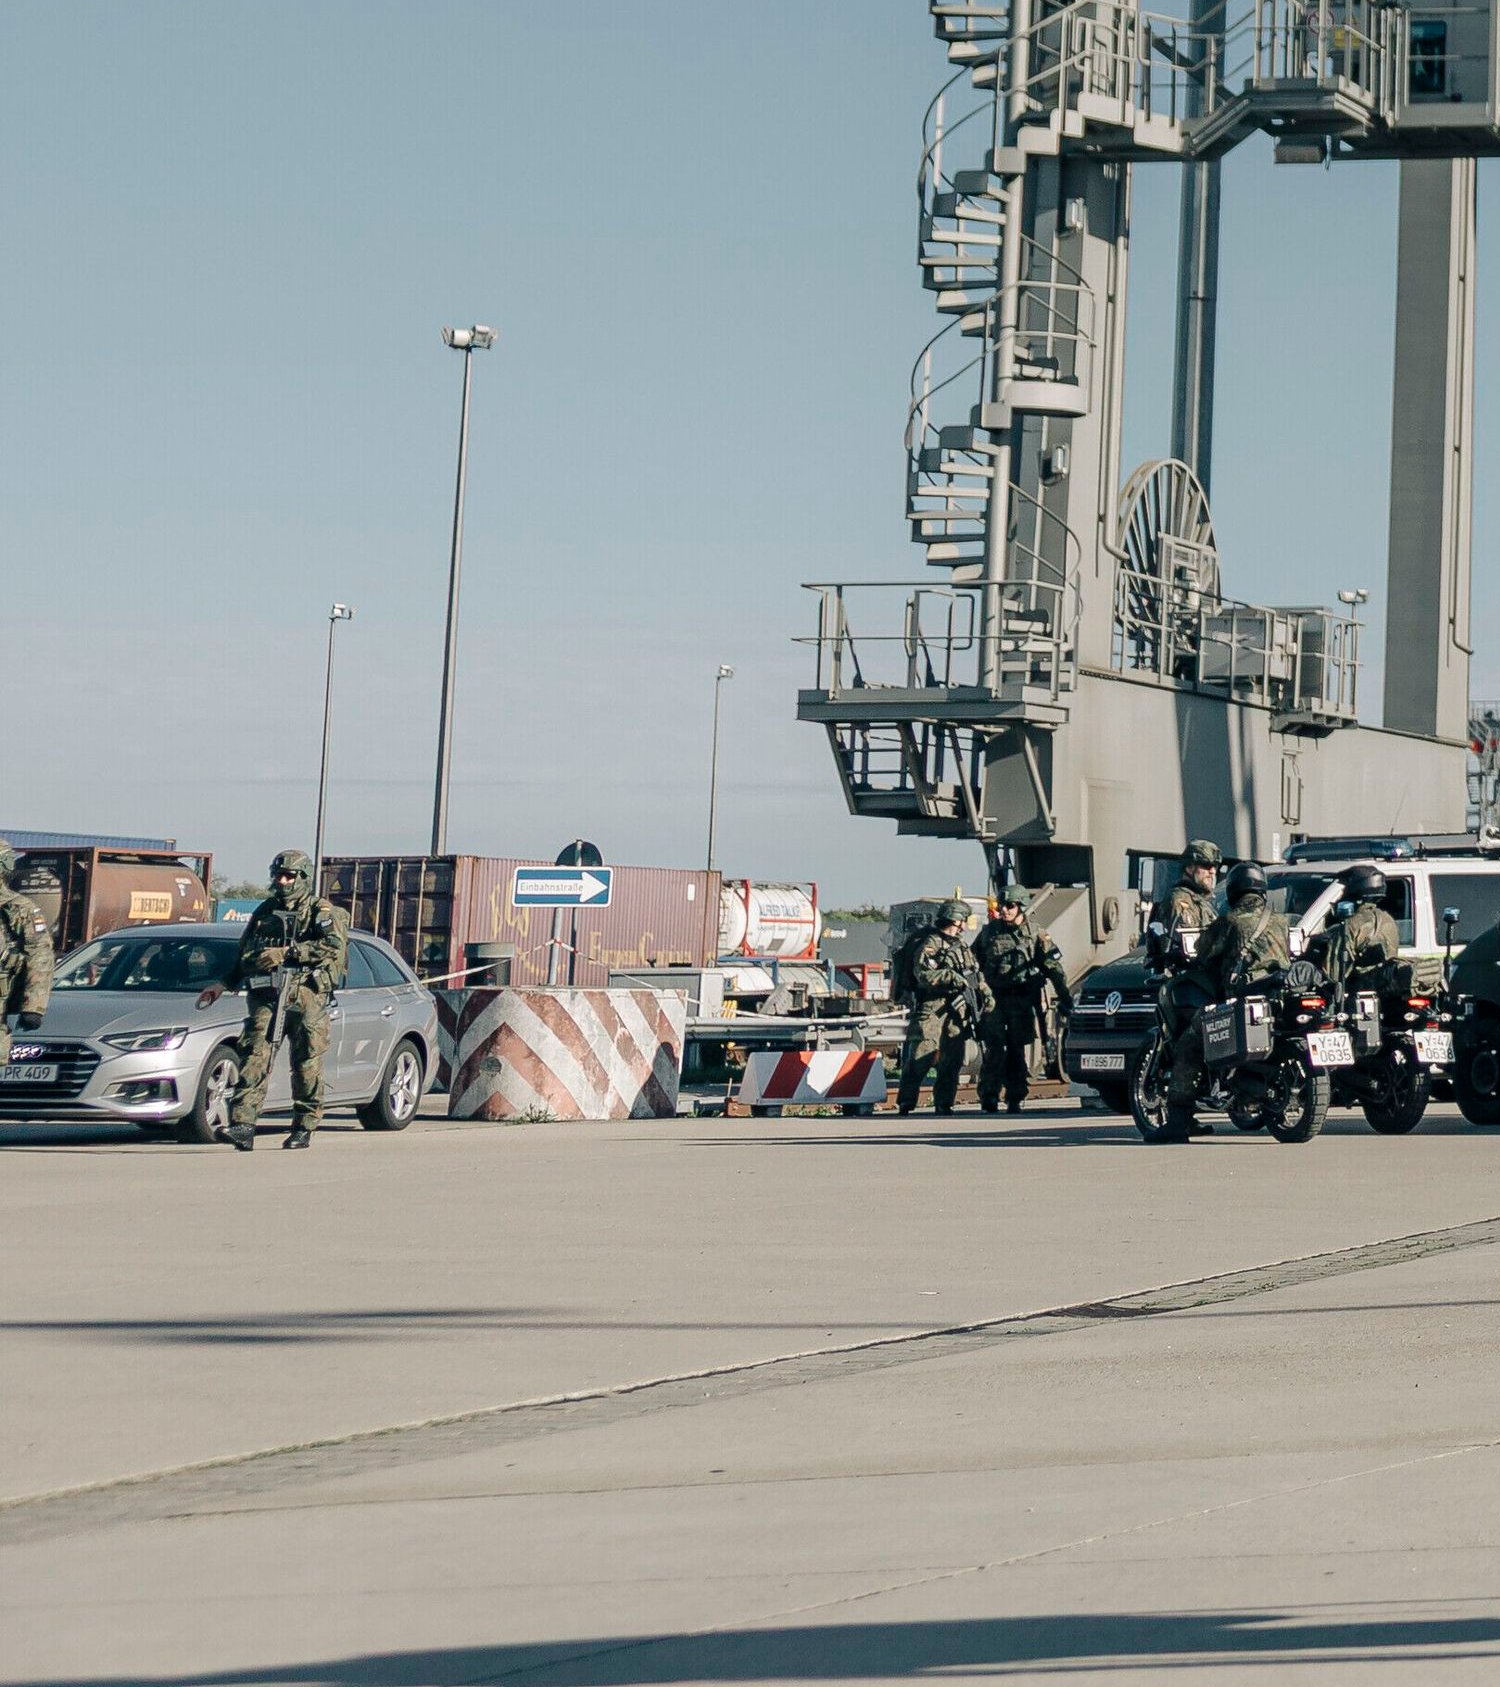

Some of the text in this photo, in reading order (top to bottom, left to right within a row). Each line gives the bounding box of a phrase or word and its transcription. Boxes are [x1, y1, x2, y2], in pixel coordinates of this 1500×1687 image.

[519, 880, 584, 892] Einbahnstraße
[1205, 1017, 1231, 1032] MILITARY
[1208, 1029, 1230, 1044] POLICE
[1319, 1048, 1351, 1063] 0635
[24, 1066, 50, 1080] 409
